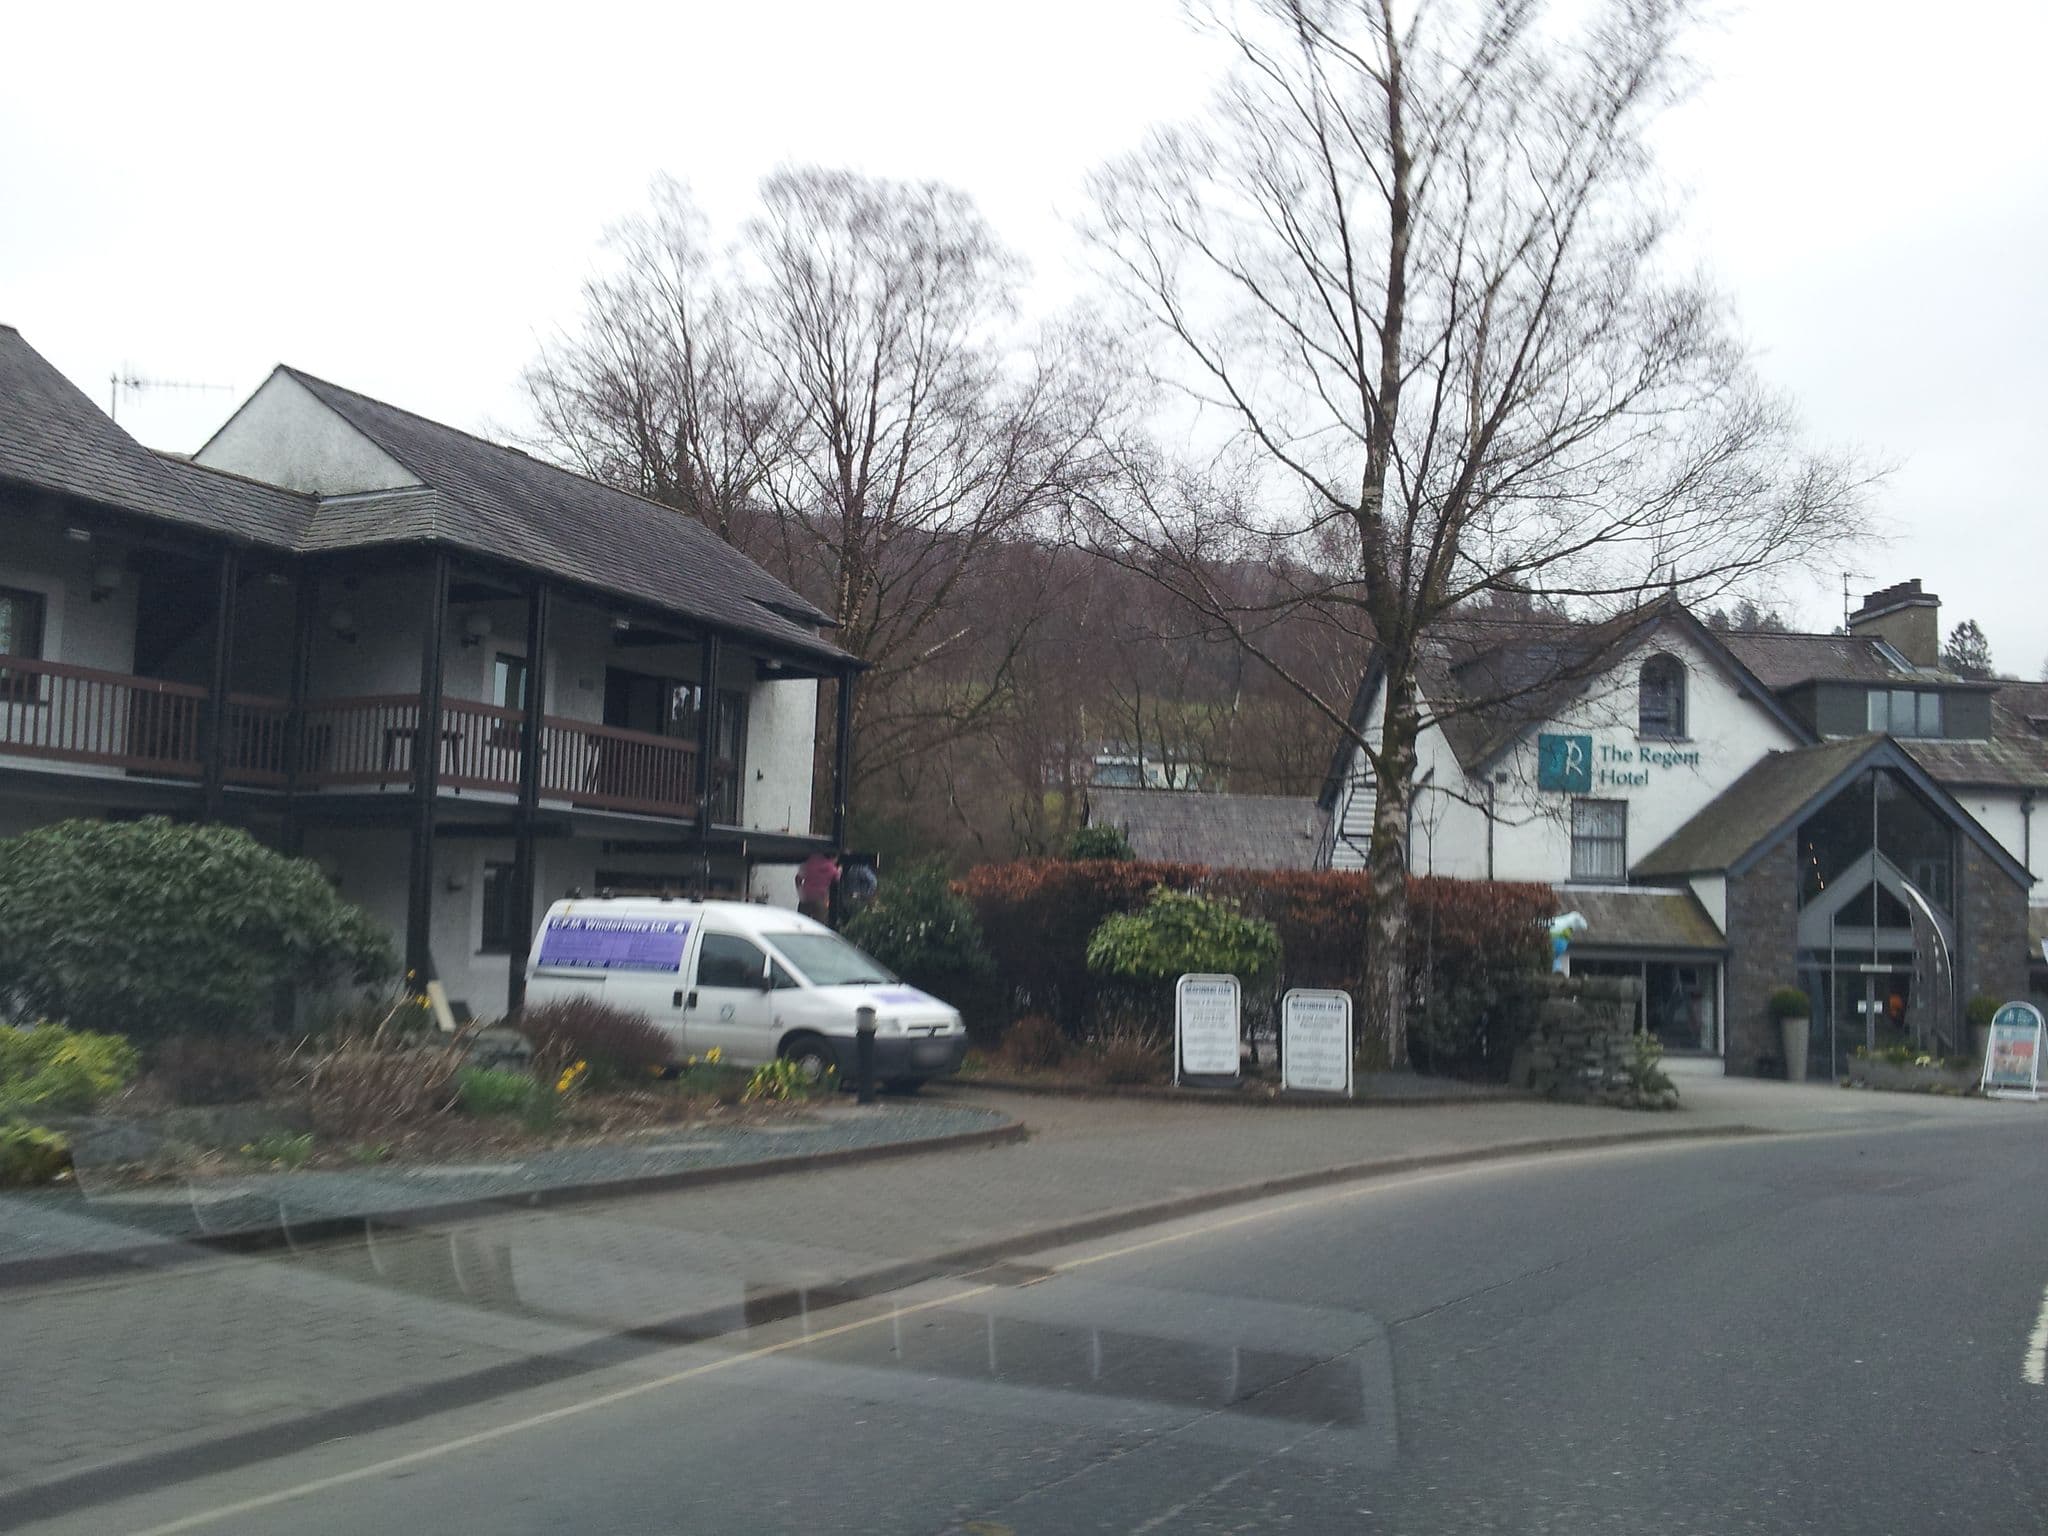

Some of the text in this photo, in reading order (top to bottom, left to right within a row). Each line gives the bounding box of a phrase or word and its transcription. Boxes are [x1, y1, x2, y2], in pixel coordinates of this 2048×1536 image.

[1601, 745, 1700, 768] The Regent
[1600, 768, 1650, 786] Hotel
